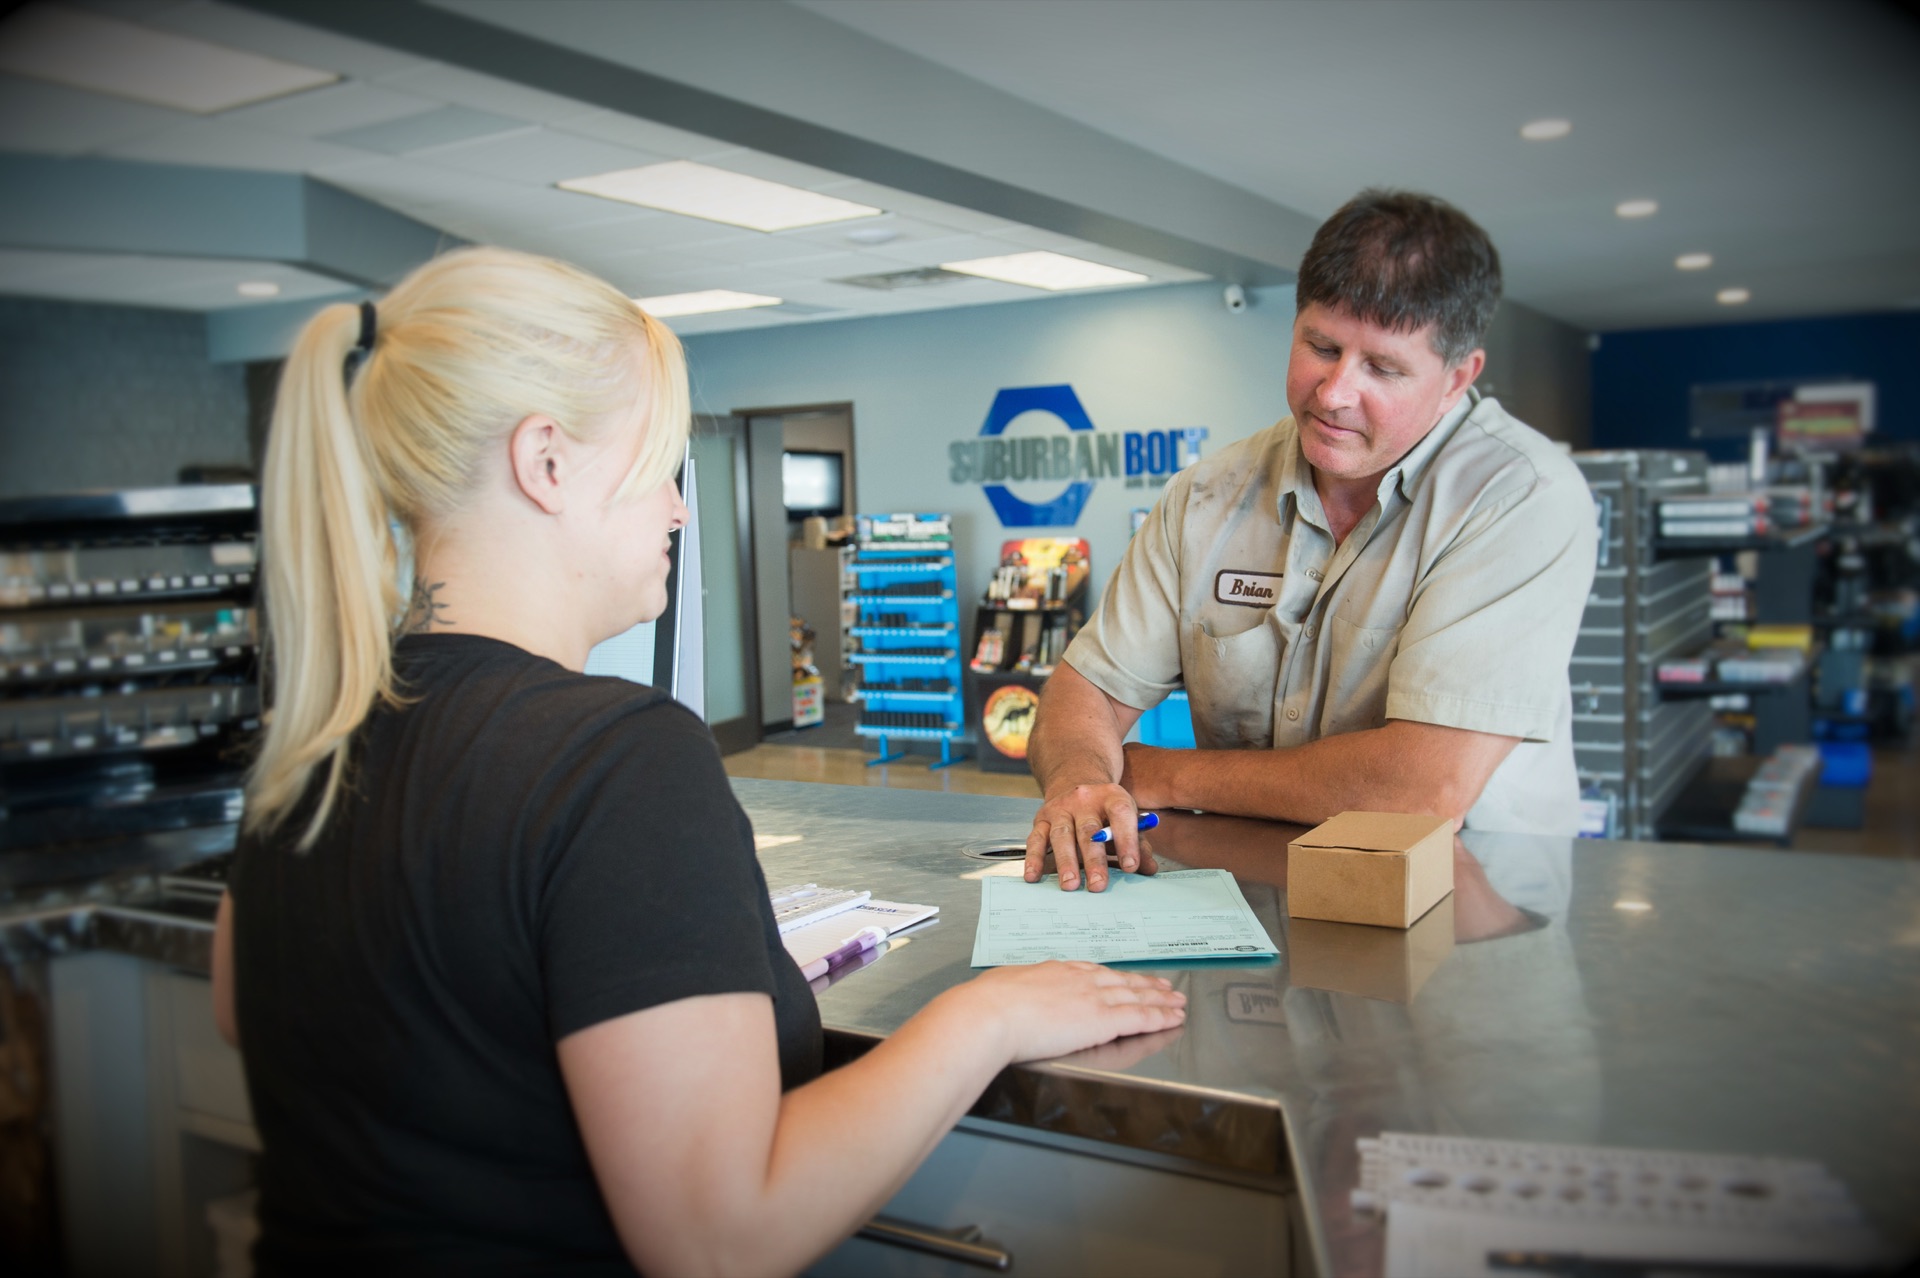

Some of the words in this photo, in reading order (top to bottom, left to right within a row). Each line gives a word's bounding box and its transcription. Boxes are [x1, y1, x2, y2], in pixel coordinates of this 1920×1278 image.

[949, 432, 1119, 485] SUBURBAN
[1124, 428, 1208, 476] BOLT
[1228, 578, 1274, 599] Brian
